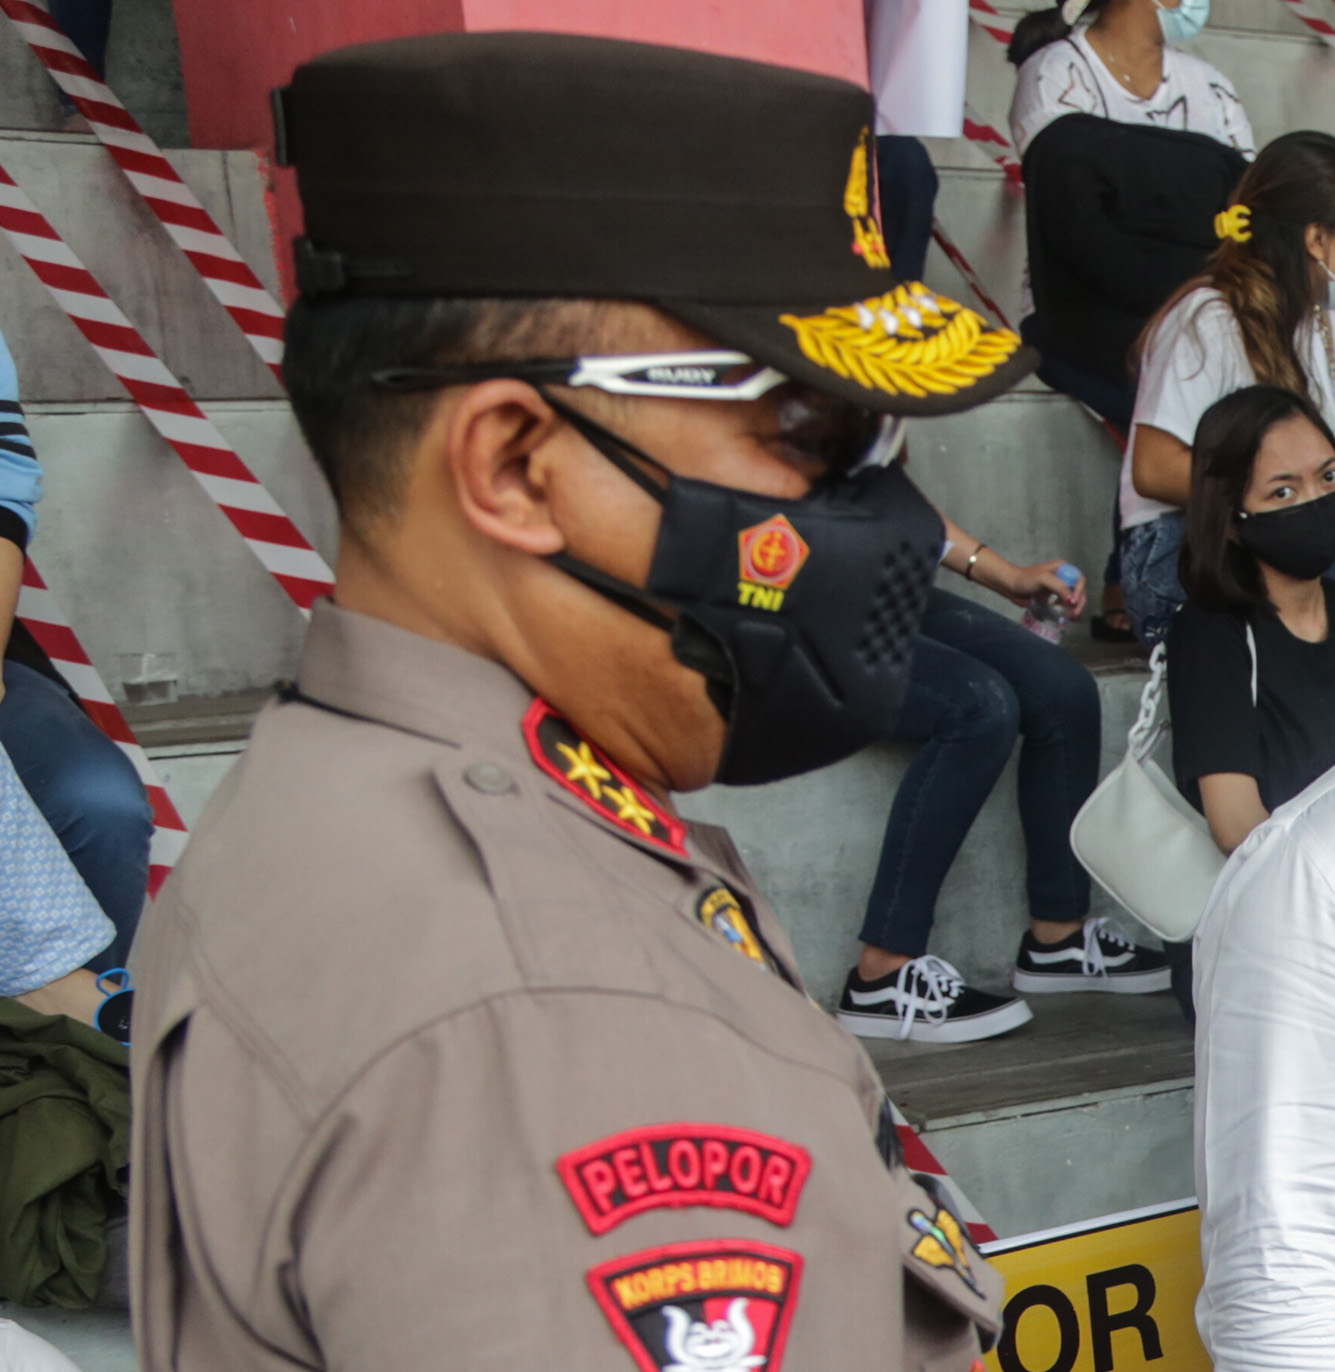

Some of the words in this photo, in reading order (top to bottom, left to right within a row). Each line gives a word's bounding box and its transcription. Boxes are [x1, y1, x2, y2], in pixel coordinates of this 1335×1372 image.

[738, 581, 785, 613] TNI
[582, 1139, 792, 1213] PELOPOR
[612, 1262, 694, 1310] KORPS
[697, 1258, 785, 1294] BRIMOB
